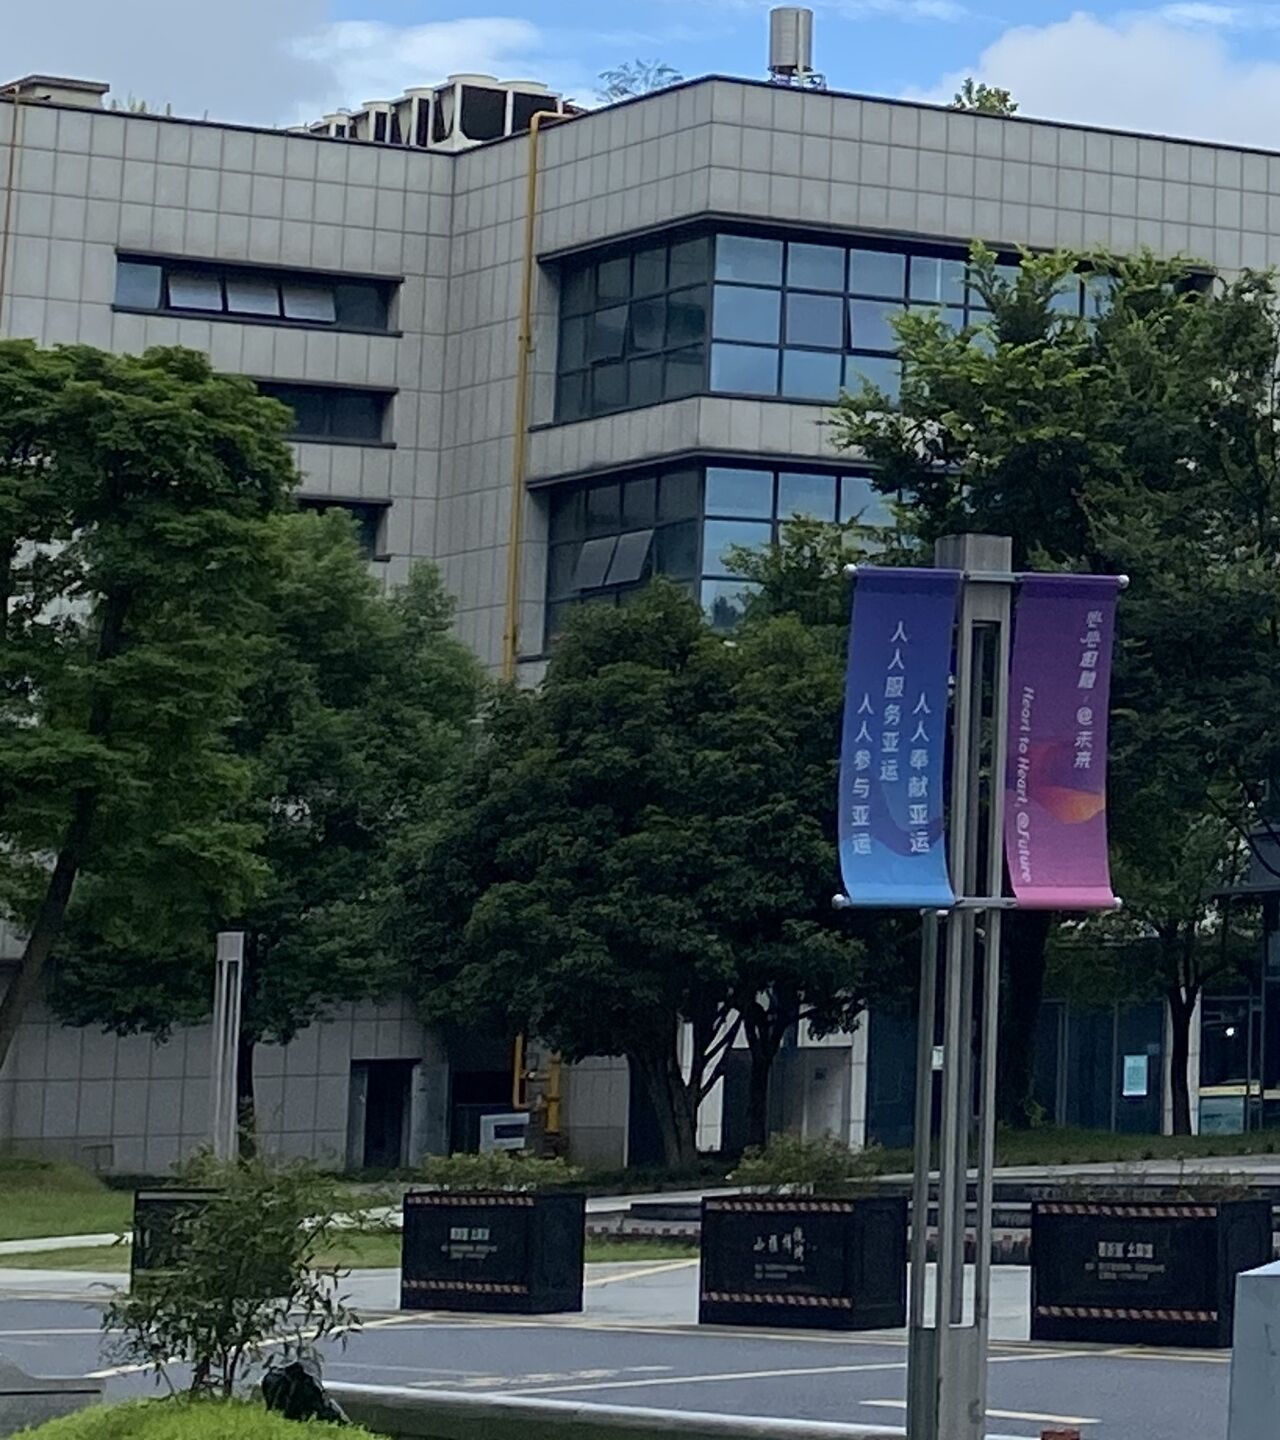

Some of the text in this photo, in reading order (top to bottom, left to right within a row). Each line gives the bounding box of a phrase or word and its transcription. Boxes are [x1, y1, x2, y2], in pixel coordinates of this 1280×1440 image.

[851, 693, 875, 855] 人人参与亚运
[880, 621, 908, 781] 人人服务亚运
[908, 693, 930, 852] 人人奉献亚运
[1014, 687, 1034, 881] Heart to Heart, @Future
